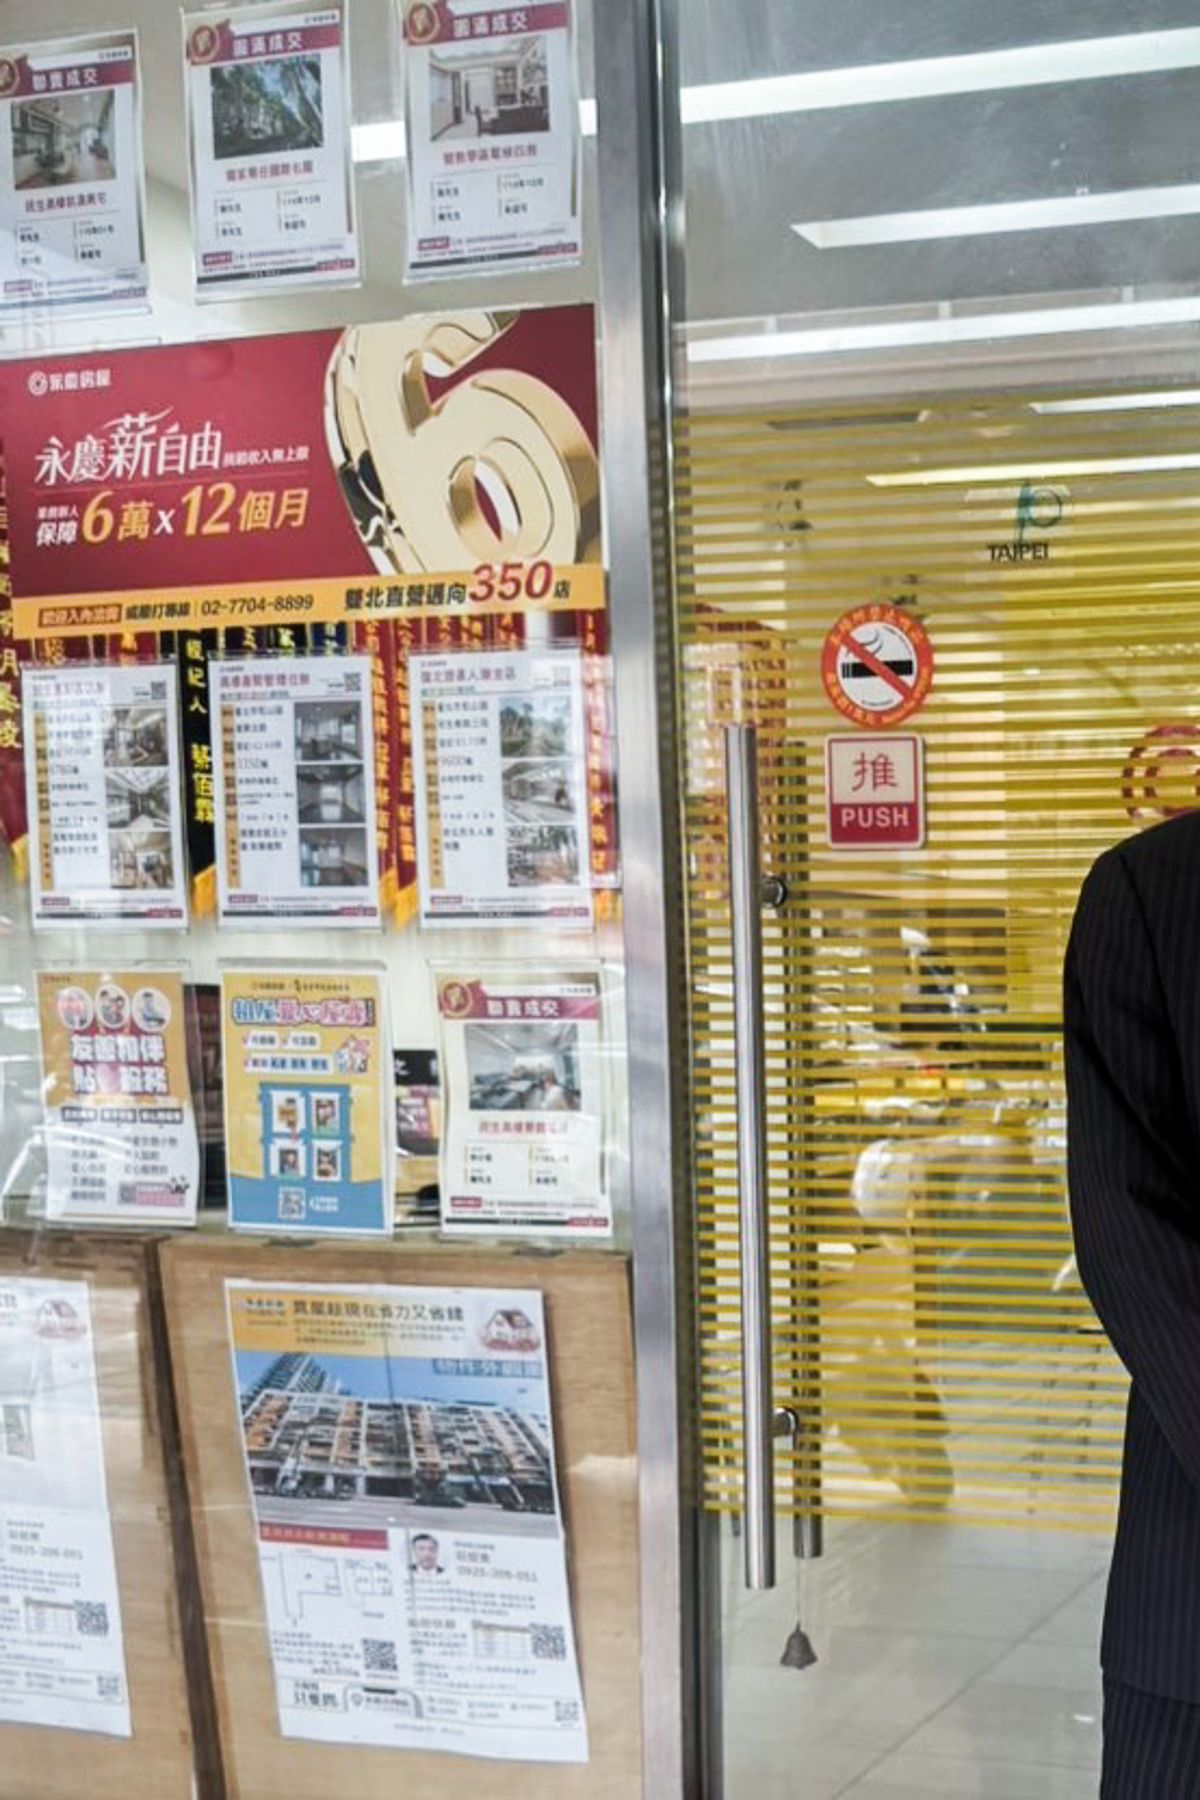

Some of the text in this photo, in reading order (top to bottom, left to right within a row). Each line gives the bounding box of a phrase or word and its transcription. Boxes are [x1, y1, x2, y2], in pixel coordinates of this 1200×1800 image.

[34, 405, 223, 487] 永慶薪自由
[986, 542, 1050, 561] TAIPEI
[201, 594, 315, 616] 02-7704-8899
[851, 751, 899, 792] 推
[840, 805, 910, 829] PUSH
